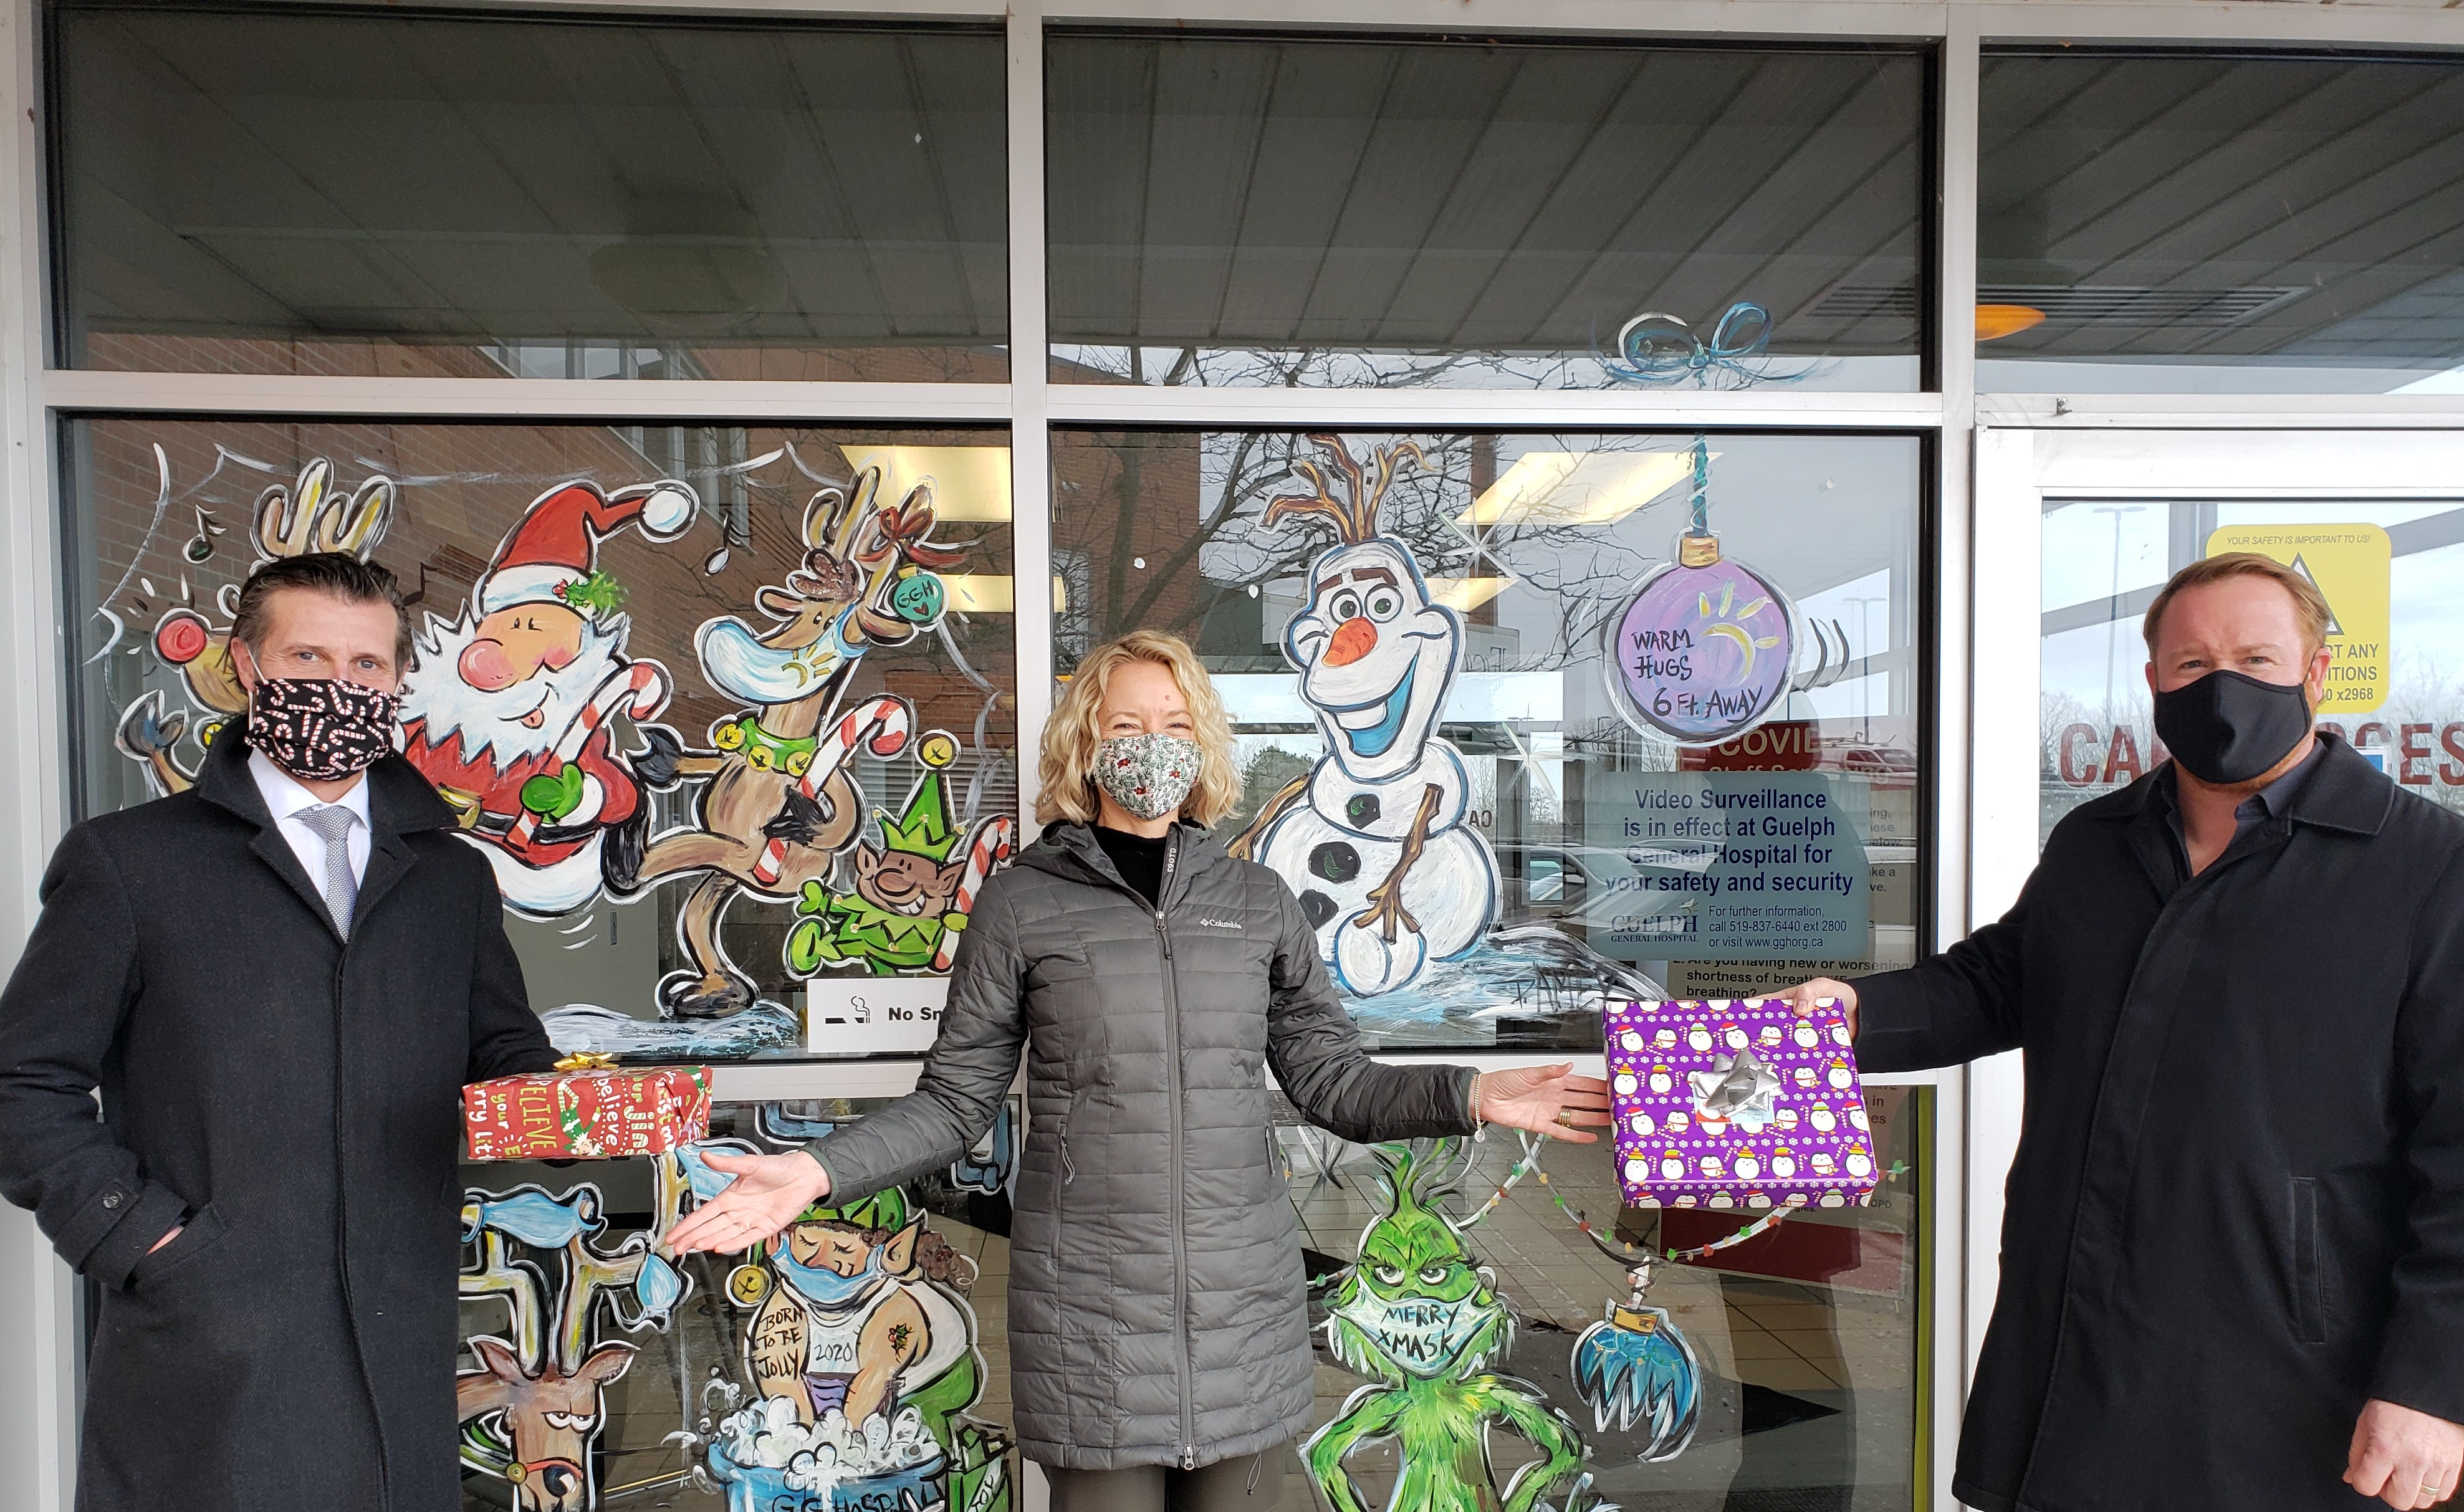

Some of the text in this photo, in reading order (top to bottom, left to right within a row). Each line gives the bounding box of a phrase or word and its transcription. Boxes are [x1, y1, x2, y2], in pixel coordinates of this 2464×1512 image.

[2227, 534, 2371, 545] YOUR SAFETY IS IMPORTANT TO US!
[896, 580, 934, 608] GGH
[1631, 628, 1695, 652] WARM
[2347, 643, 2379, 658] ANY
[1634, 655, 1692, 681] HUGS
[2326, 666, 2377, 681] ITIONS
[2337, 687, 2374, 701] x2968
[1652, 687, 1672, 716] 6
[1704, 685, 1762, 723] AWAY
[1634, 788, 1827, 810] Video Surveillance
[1624, 816, 1835, 841] is in effect at Guelph
[1870, 824, 1895, 833] ese
[1626, 843, 1833, 868] General Hospital for
[1888, 869, 1896, 877] a
[1604, 871, 1853, 897] your safety and security
[1709, 905, 1824, 918] For further information,
[1209, 919, 1242, 929] Columbia
[1709, 920, 1847, 932] call 519-837-6440 ext 2800
[1611, 934, 1699, 943] GENERAL HOSPITAL
[1709, 935, 1824, 950] or visit www.gghorg.ca
[1790, 960, 1817, 969] new
[1820, 960, 1836, 969] or
[1687, 970, 1752, 983] shortness
[1755, 972, 1770, 983] of
[1686, 985, 1757, 998] breathing?
[888, 1007, 913, 1021] No
[1872, 1094, 1884, 1107] in
[491, 1093, 510, 1130] your
[760, 1307, 803, 1333] BORN
[1379, 1303, 1460, 1328] MERRY
[774, 1326, 802, 1345] BE
[814, 1342, 853, 1362] 2020
[758, 1347, 799, 1381] JOLLY
